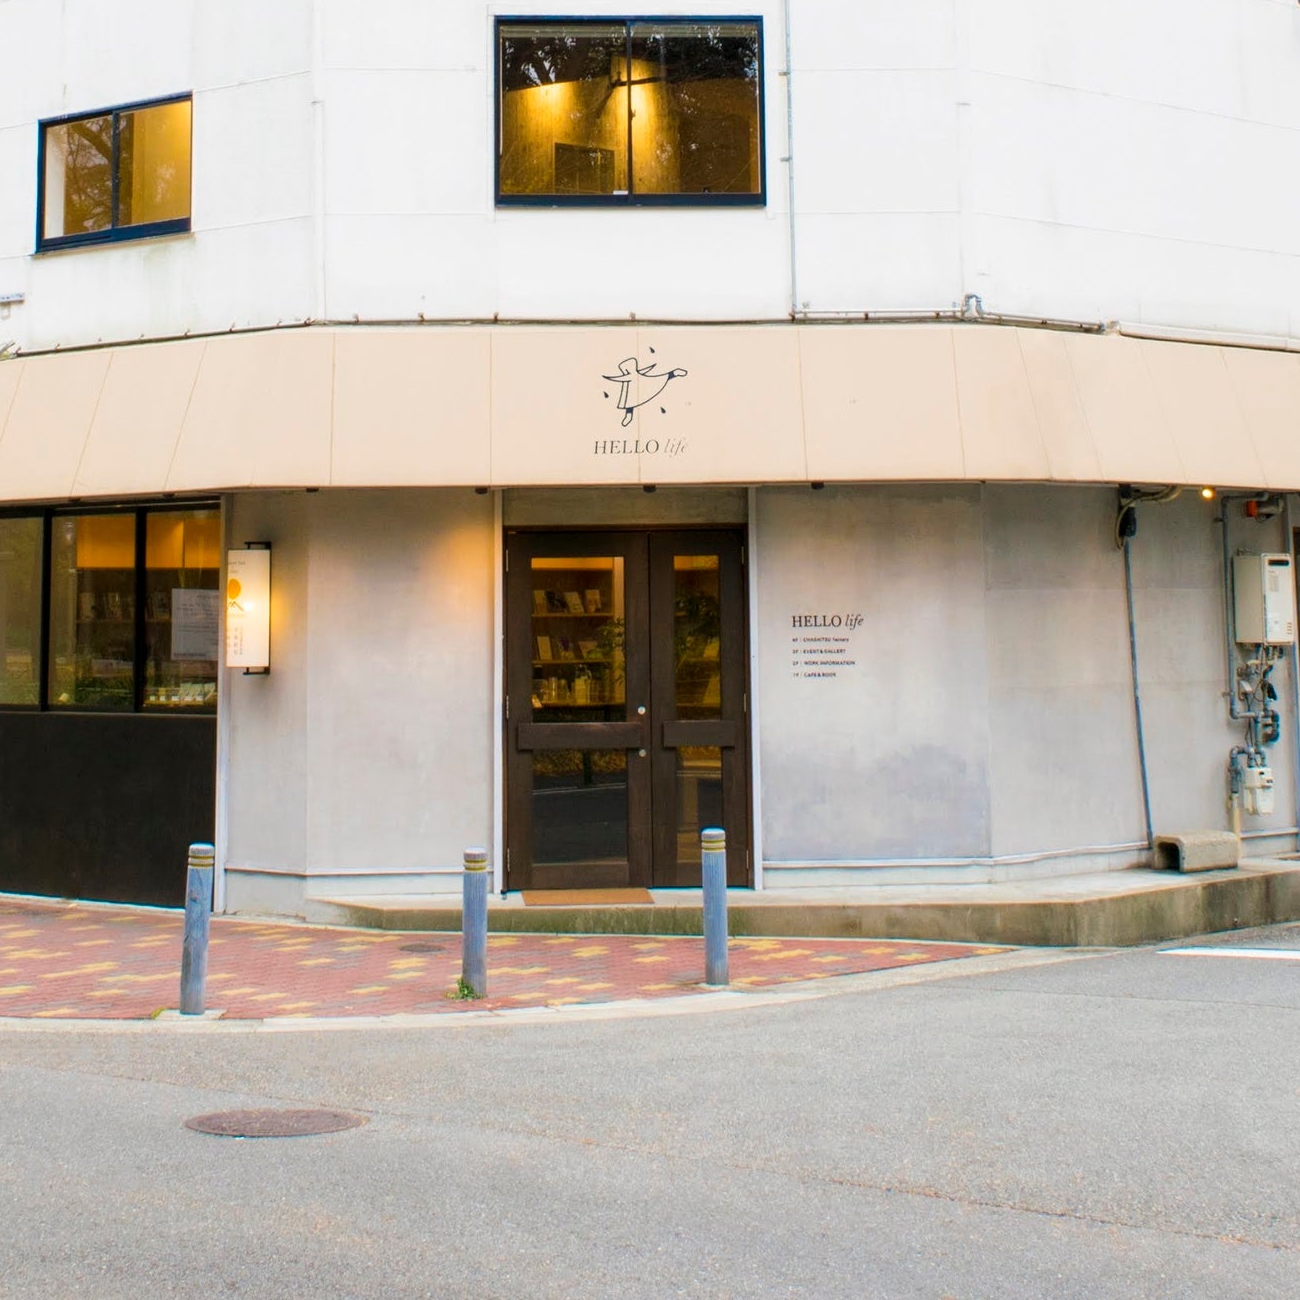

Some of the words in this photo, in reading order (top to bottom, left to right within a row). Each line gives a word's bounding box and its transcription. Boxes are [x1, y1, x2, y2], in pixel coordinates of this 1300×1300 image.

[594, 439, 660, 454] HELLO
[663, 437, 689, 457] life
[792, 615, 842, 628] HELLO
[845, 614, 864, 630] life
